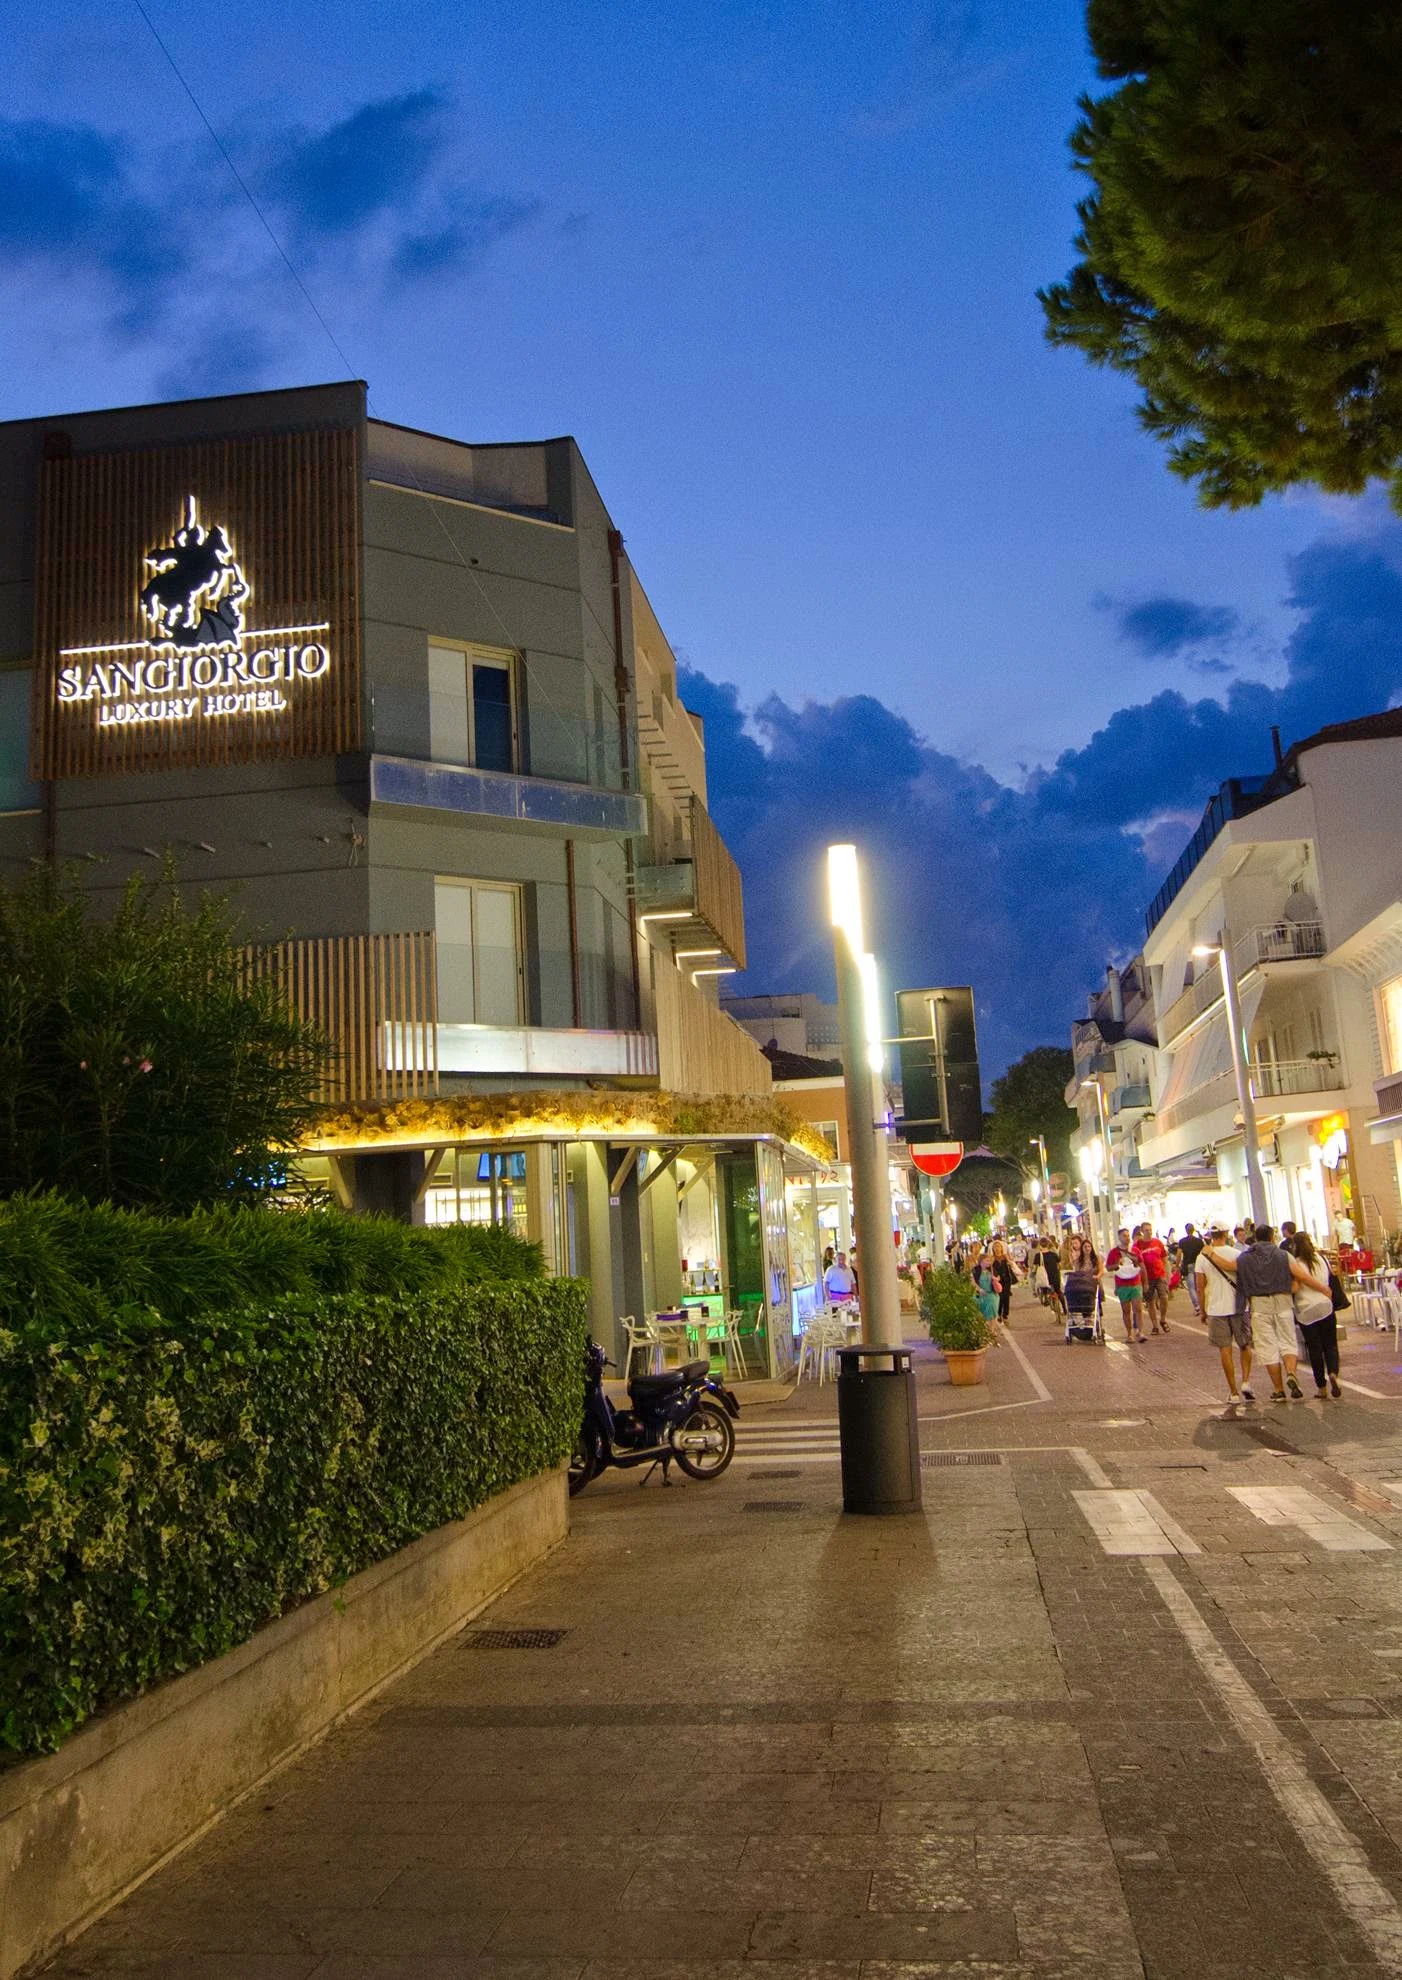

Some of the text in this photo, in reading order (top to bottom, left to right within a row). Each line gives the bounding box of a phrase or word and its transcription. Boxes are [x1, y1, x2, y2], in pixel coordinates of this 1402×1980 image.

[57, 643, 330, 702] SANGIORGIO
[100, 689, 287, 725] LUXURY HOTEL
